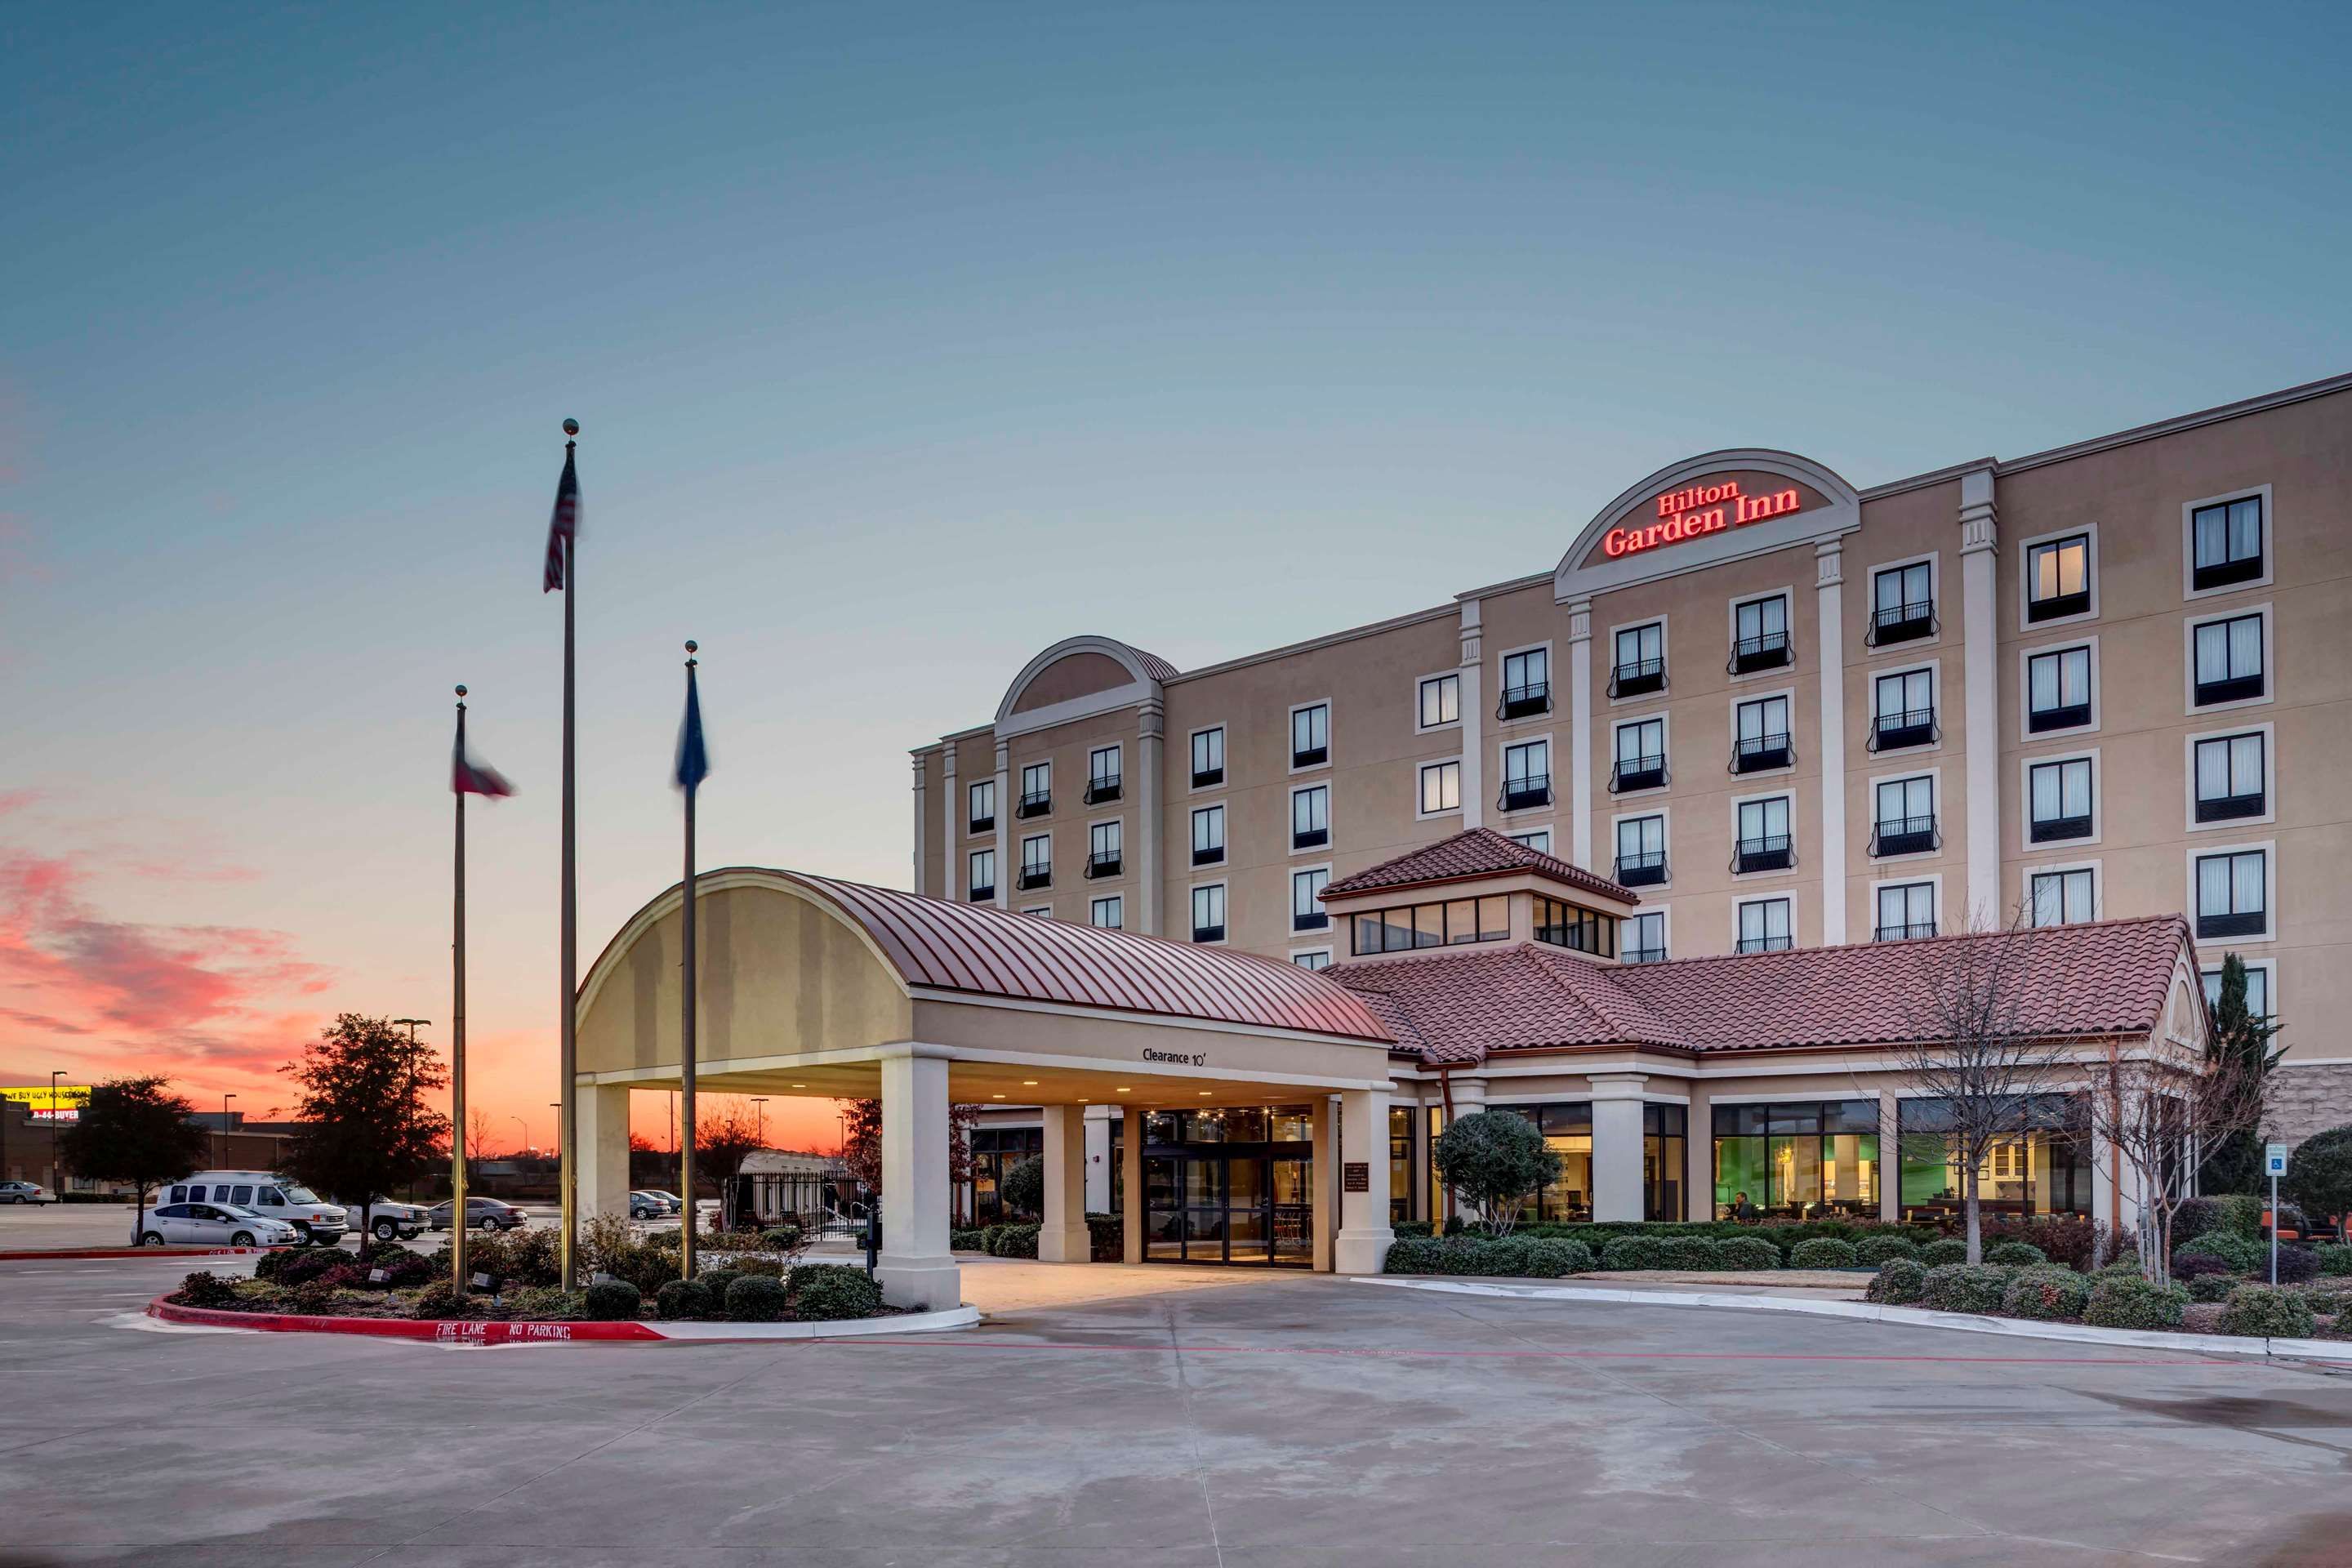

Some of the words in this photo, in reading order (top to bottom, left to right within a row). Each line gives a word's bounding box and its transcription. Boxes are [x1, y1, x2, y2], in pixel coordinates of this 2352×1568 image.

[1658, 481, 1740, 518] Hilton
[1605, 507, 1726, 558] Garden
[1735, 488, 1801, 525] Inn
[1143, 1048, 1189, 1064] Clearance
[1192, 1052, 1206, 1067] 10'
[19, 1091, 31, 1100] BUY
[32, 1090, 47, 1099] UGLY
[436, 1323, 457, 1336] FIRE
[461, 1323, 488, 1336] LANE
[510, 1323, 523, 1336] NO
[528, 1324, 572, 1339] PARKING
